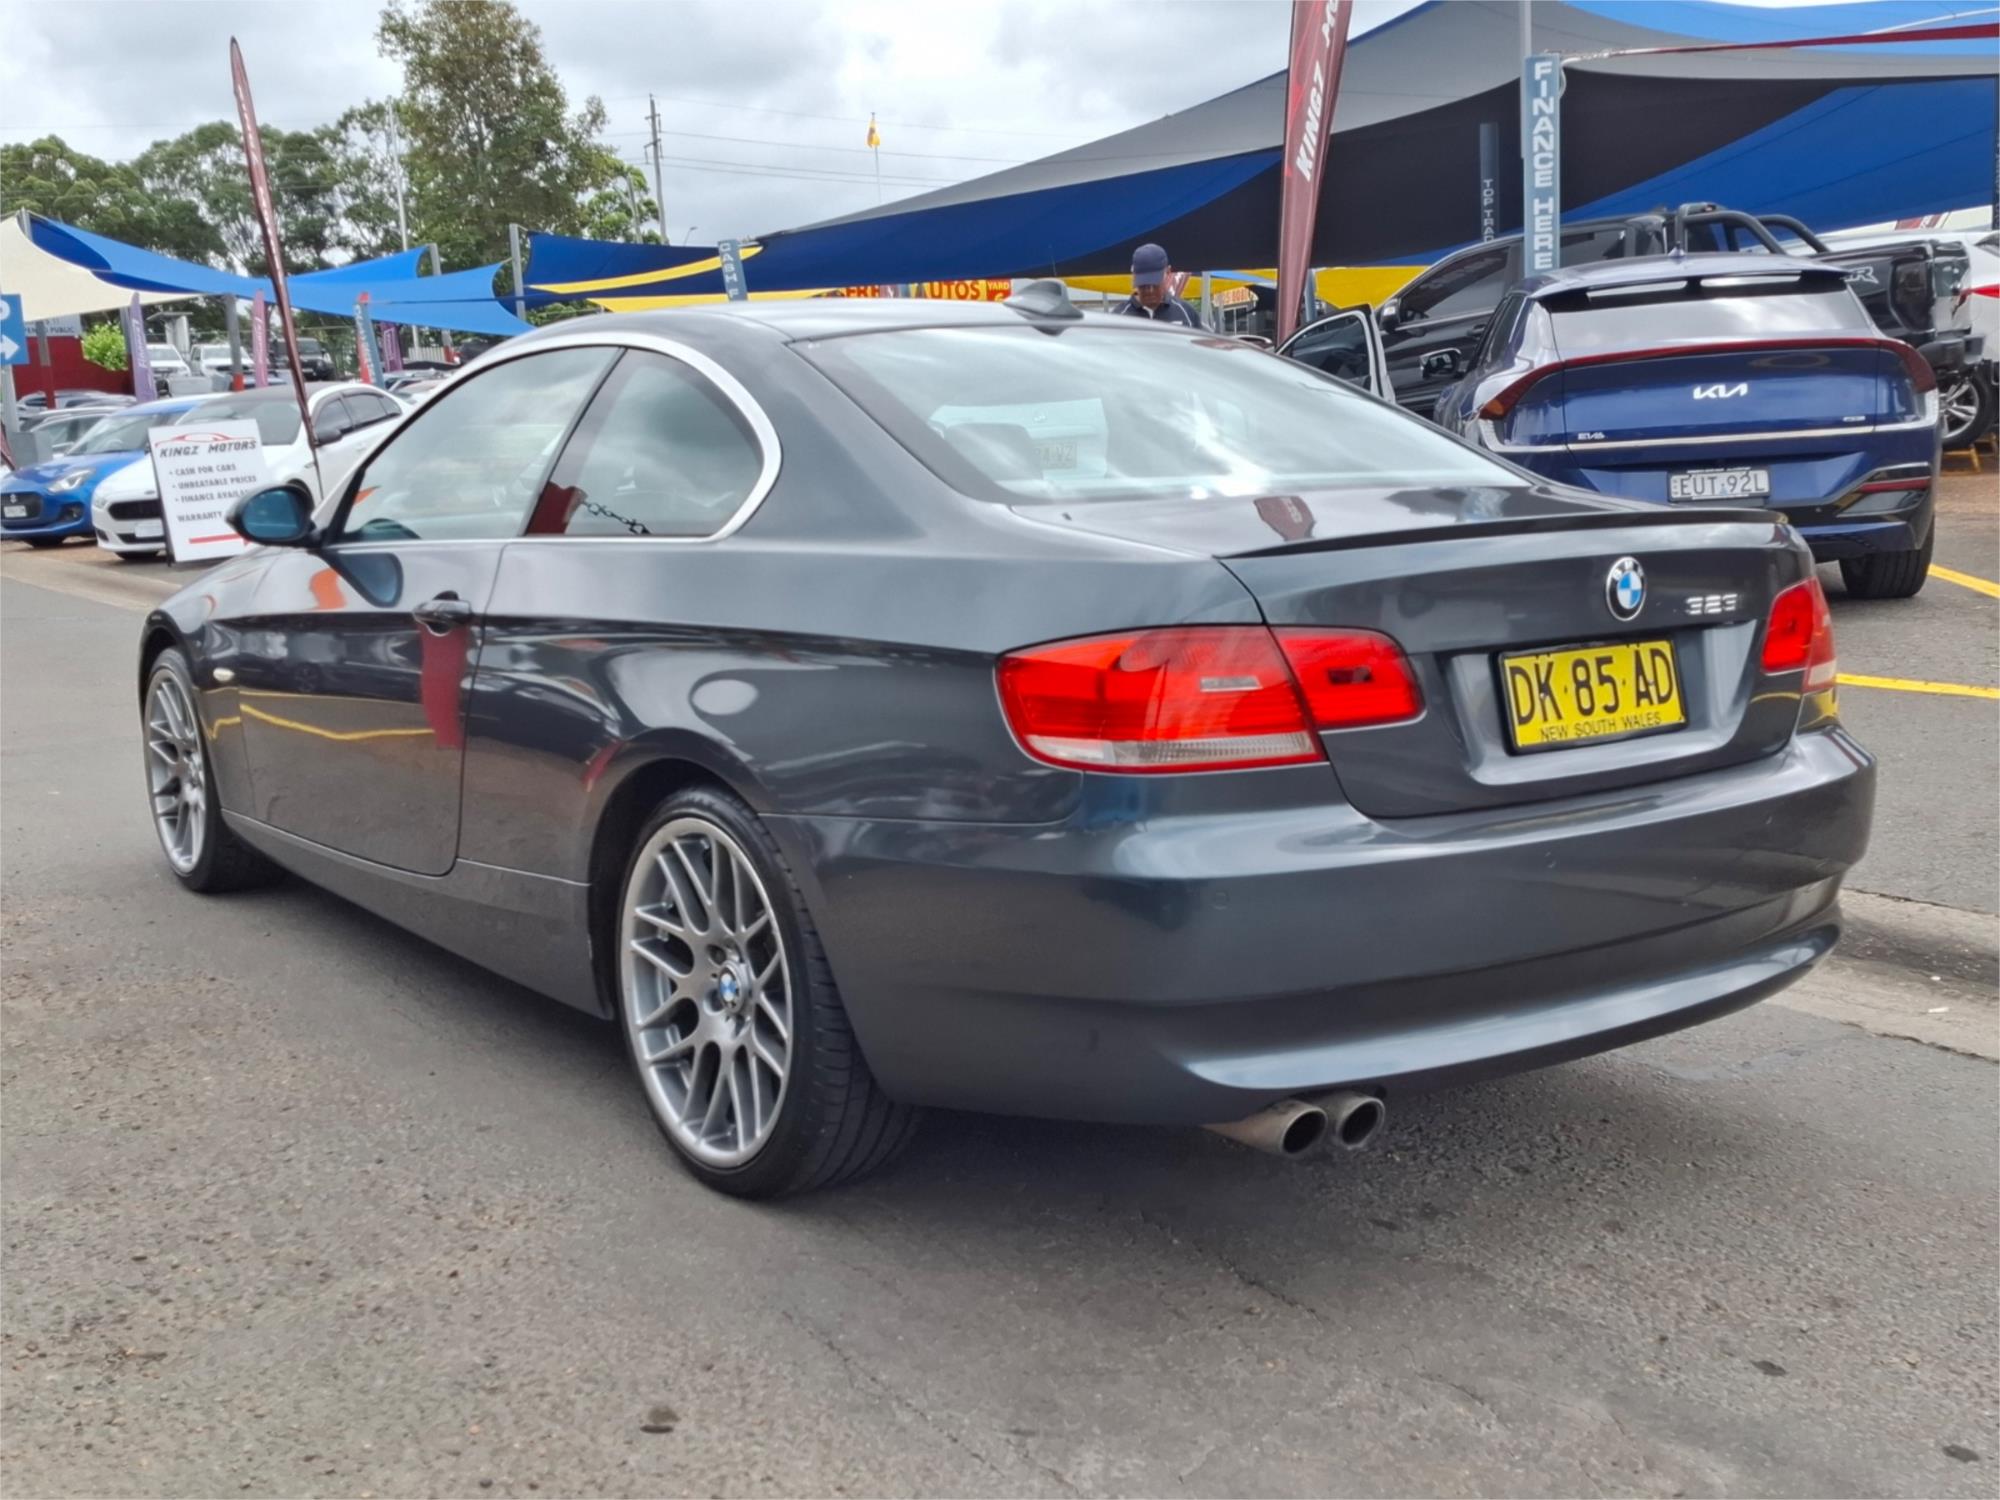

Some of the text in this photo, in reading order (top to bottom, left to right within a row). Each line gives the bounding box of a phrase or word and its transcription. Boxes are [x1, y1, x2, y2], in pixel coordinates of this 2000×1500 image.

[1532, 61, 1555, 270] FINANCE HERE
[1483, 179, 1494, 206] TOP
[720, 242, 738, 283] CASH
[986, 280, 1010, 290] YARD
[1693, 382, 1749, 400] KIA
[159, 440, 257, 458] KINGZ MOTORS
[175, 463, 237, 477] CASH FOR CARS
[178, 475, 257, 490] UNBEATABLE PRICES
[1679, 475, 1718, 496] EUT
[1726, 470, 1766, 493] 92L
[180, 491, 214, 503] FINANCE
[176, 511, 223, 523] WARRANTY
[1508, 647, 1674, 726] DK 85 AD
[1539, 712, 1662, 742] NEW SOUTH WALES
